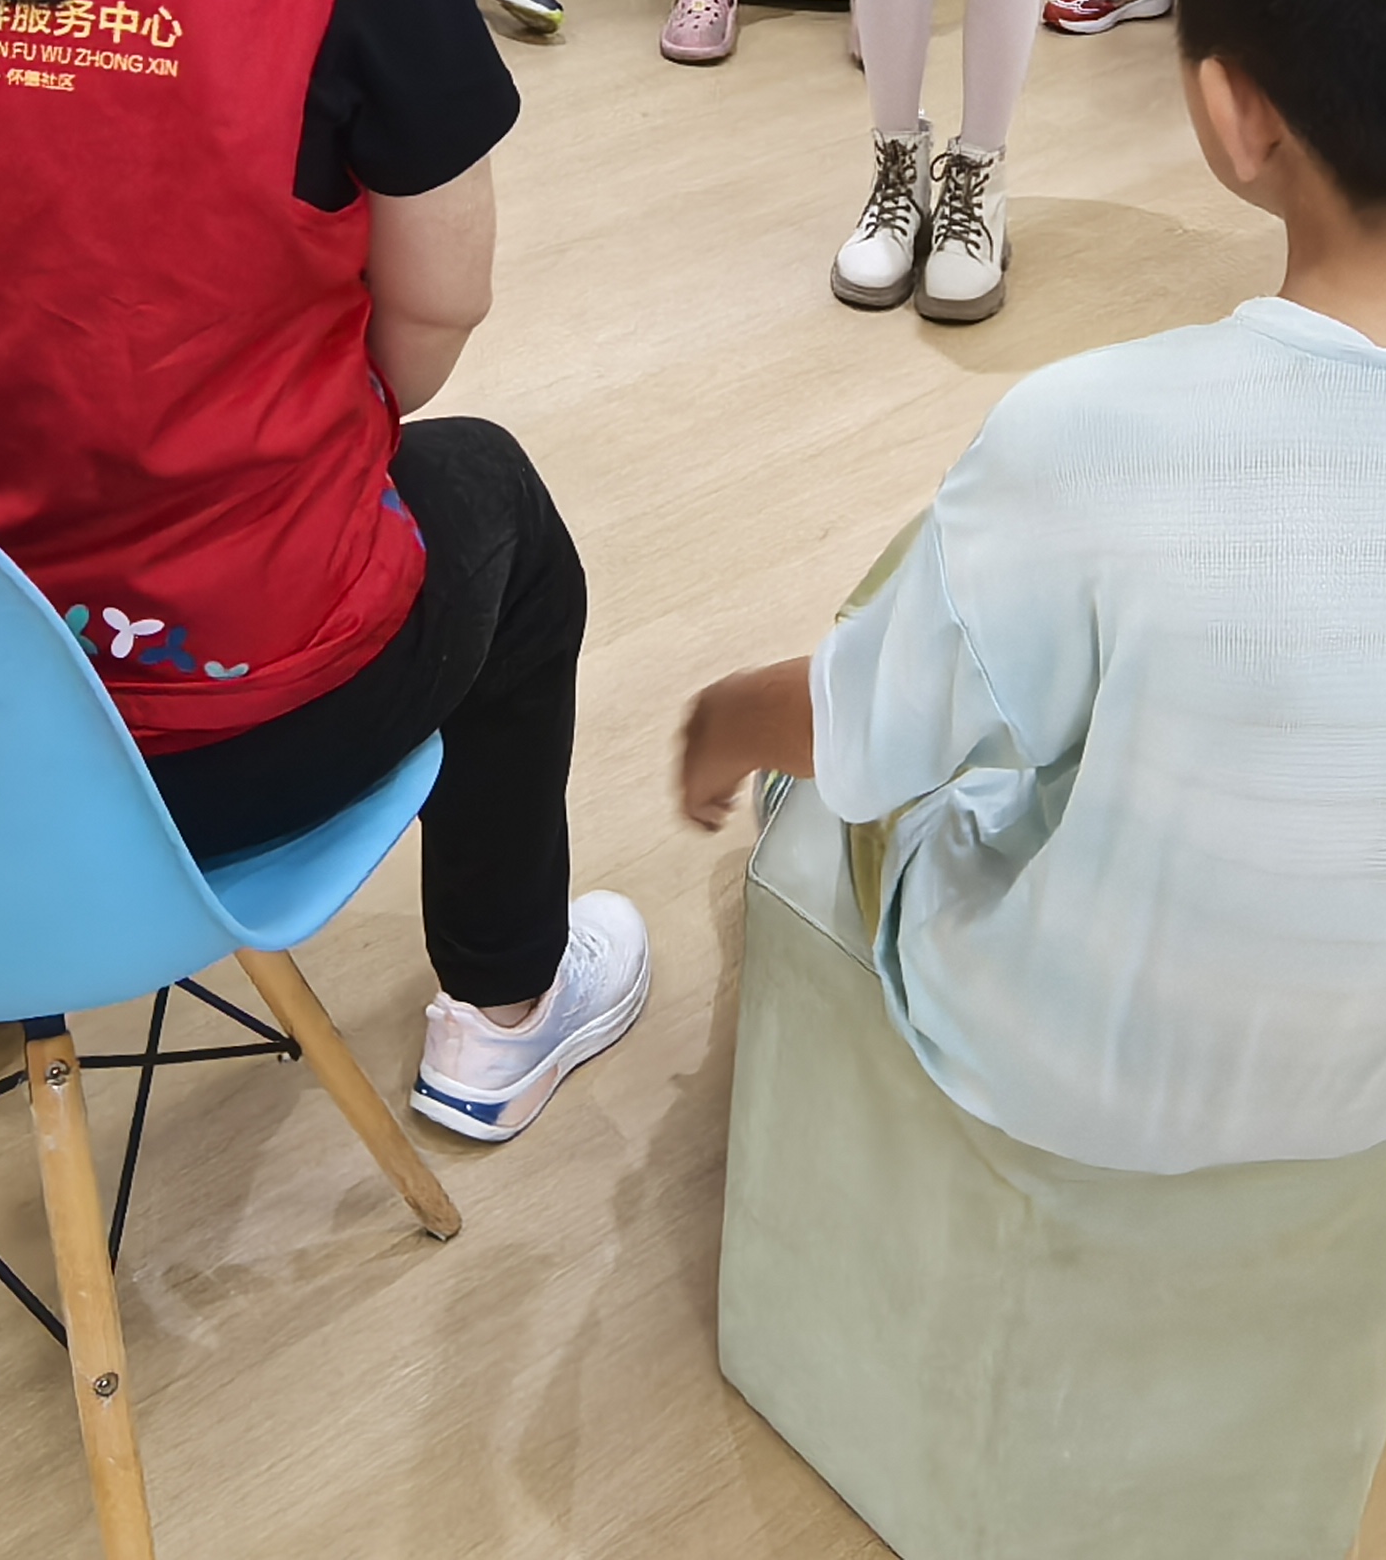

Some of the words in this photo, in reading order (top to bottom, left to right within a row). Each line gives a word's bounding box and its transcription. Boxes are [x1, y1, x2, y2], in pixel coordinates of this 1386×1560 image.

[13, 42, 38, 61] FU
[41, 43, 72, 65] WU
[74, 48, 145, 74] ZHONG
[146, 57, 179, 79] XIN
